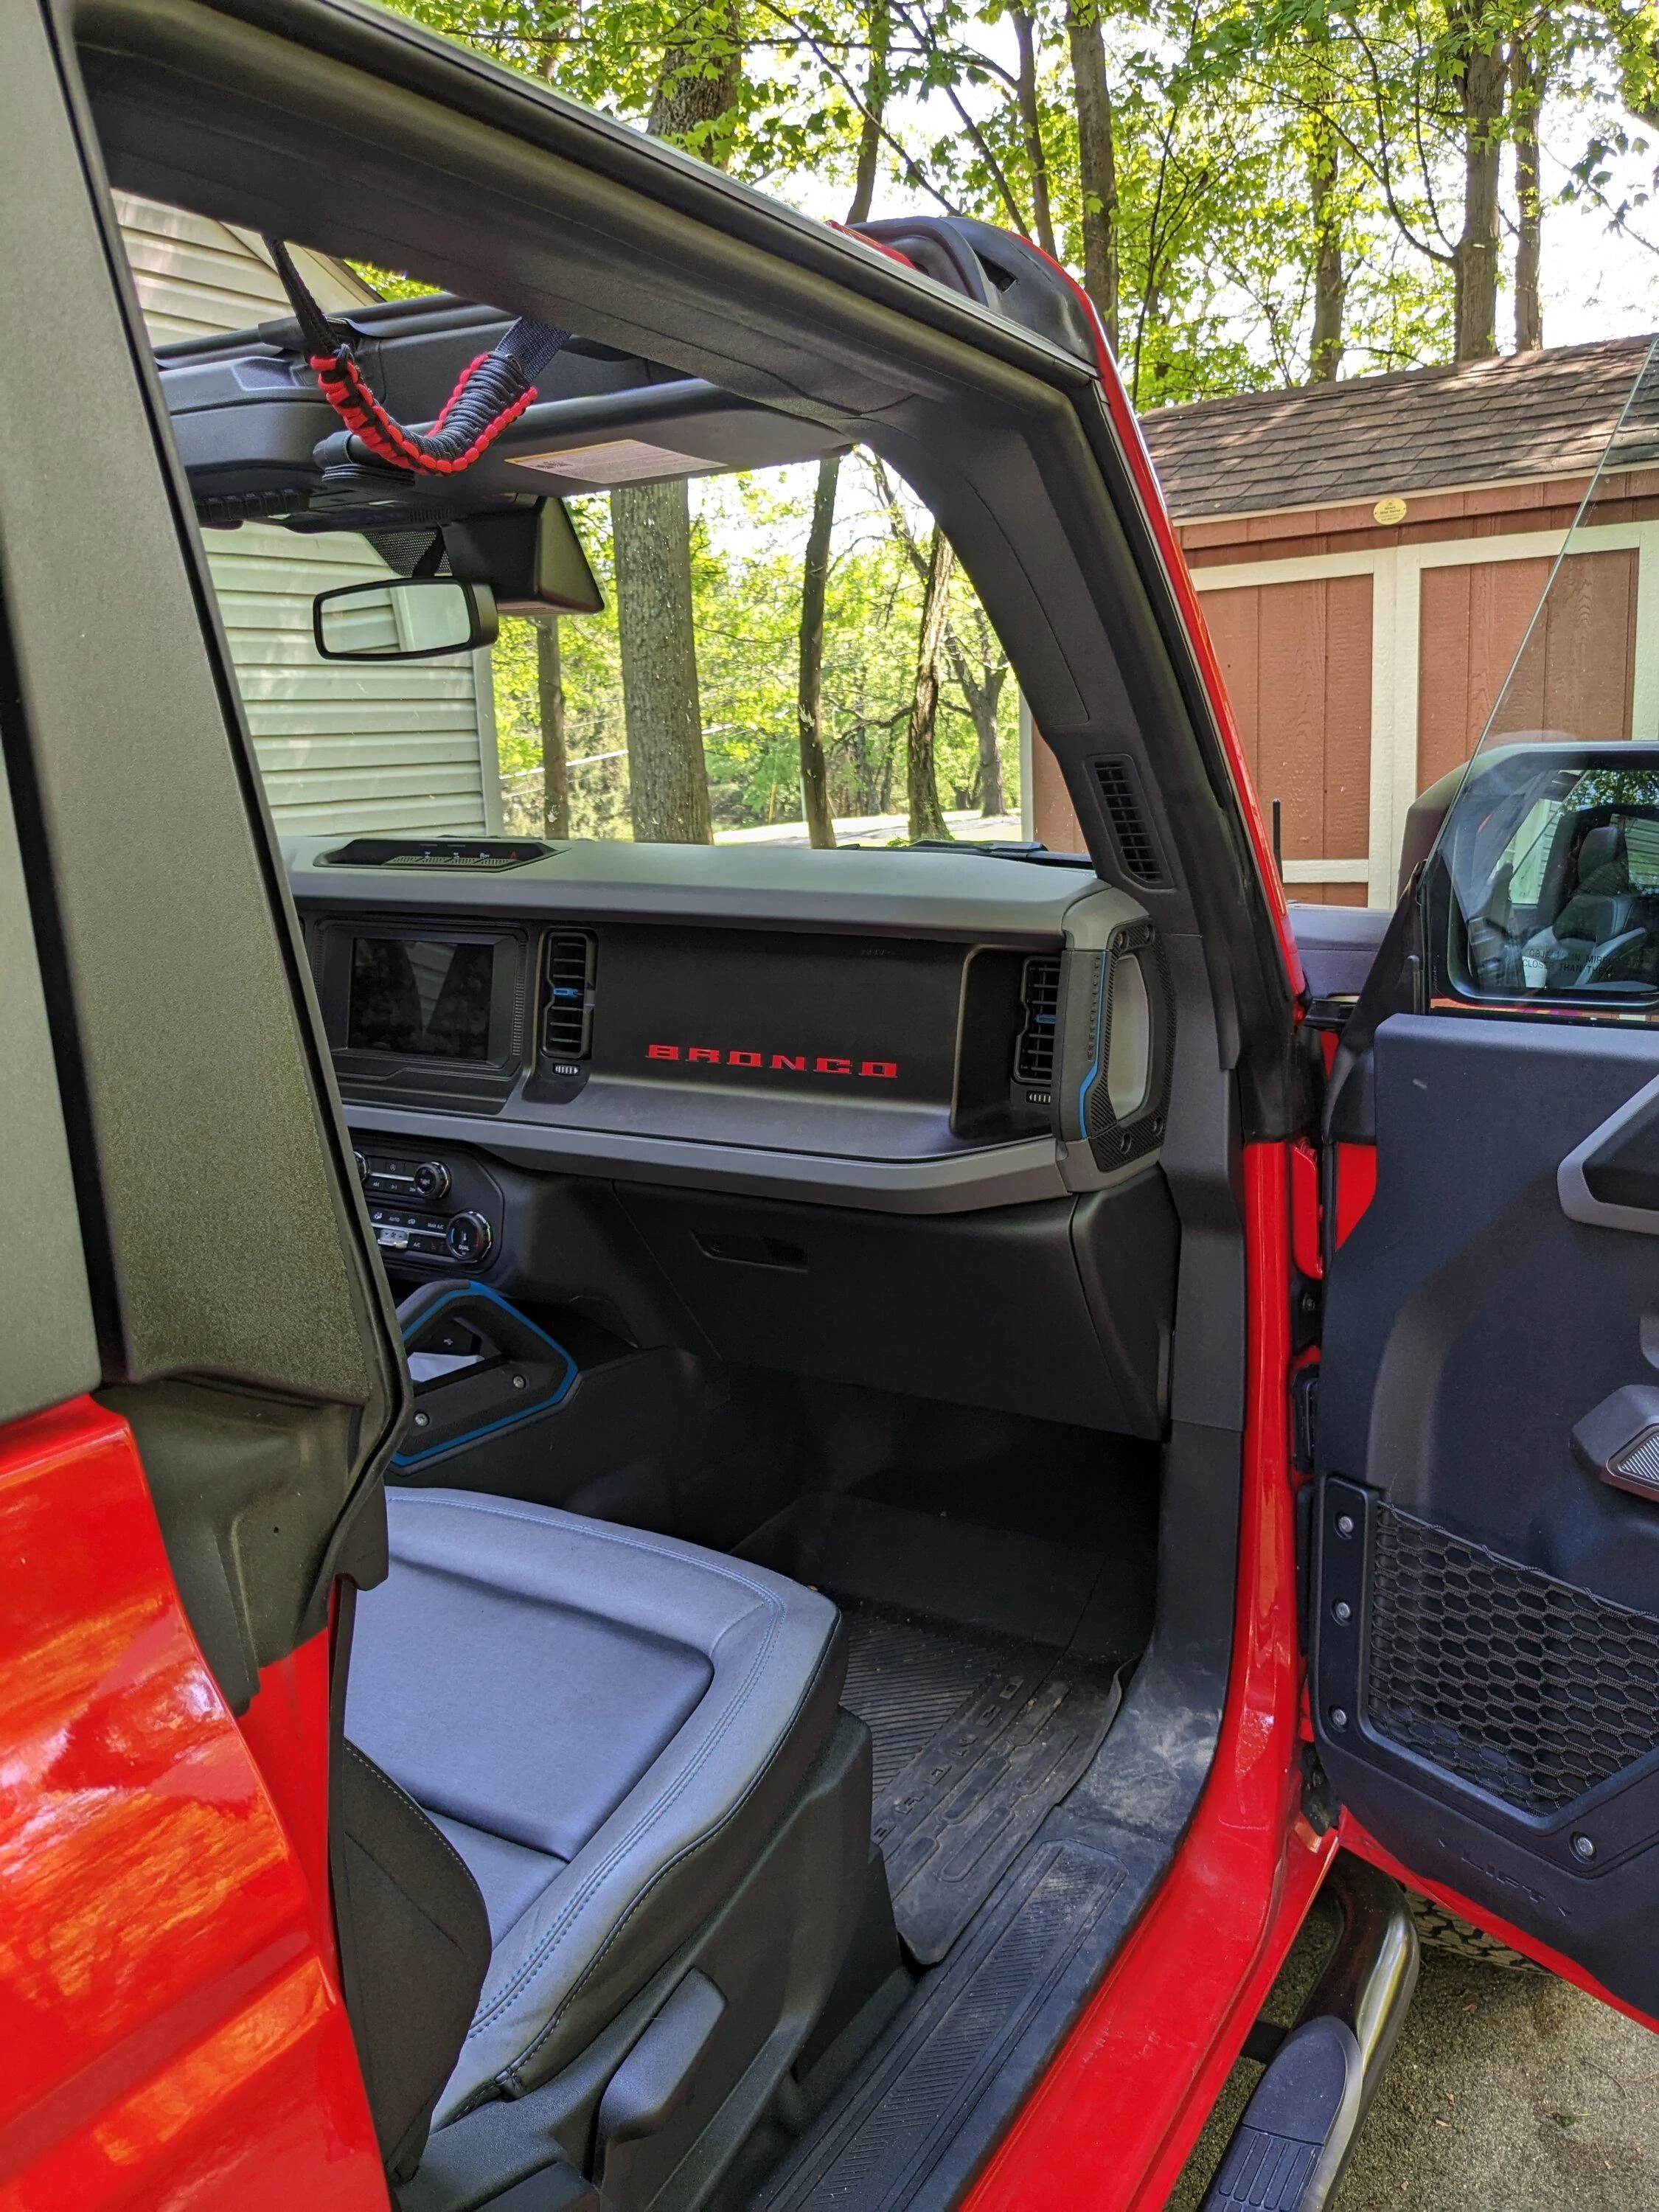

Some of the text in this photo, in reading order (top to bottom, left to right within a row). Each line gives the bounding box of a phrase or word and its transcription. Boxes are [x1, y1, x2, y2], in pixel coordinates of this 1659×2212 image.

[1529, 949, 1571, 961] OBJE
[1559, 963, 1582, 973] THAN
[645, 1044, 898, 1078] BRONCO
[872, 1675, 1025, 1845] BRONCO
